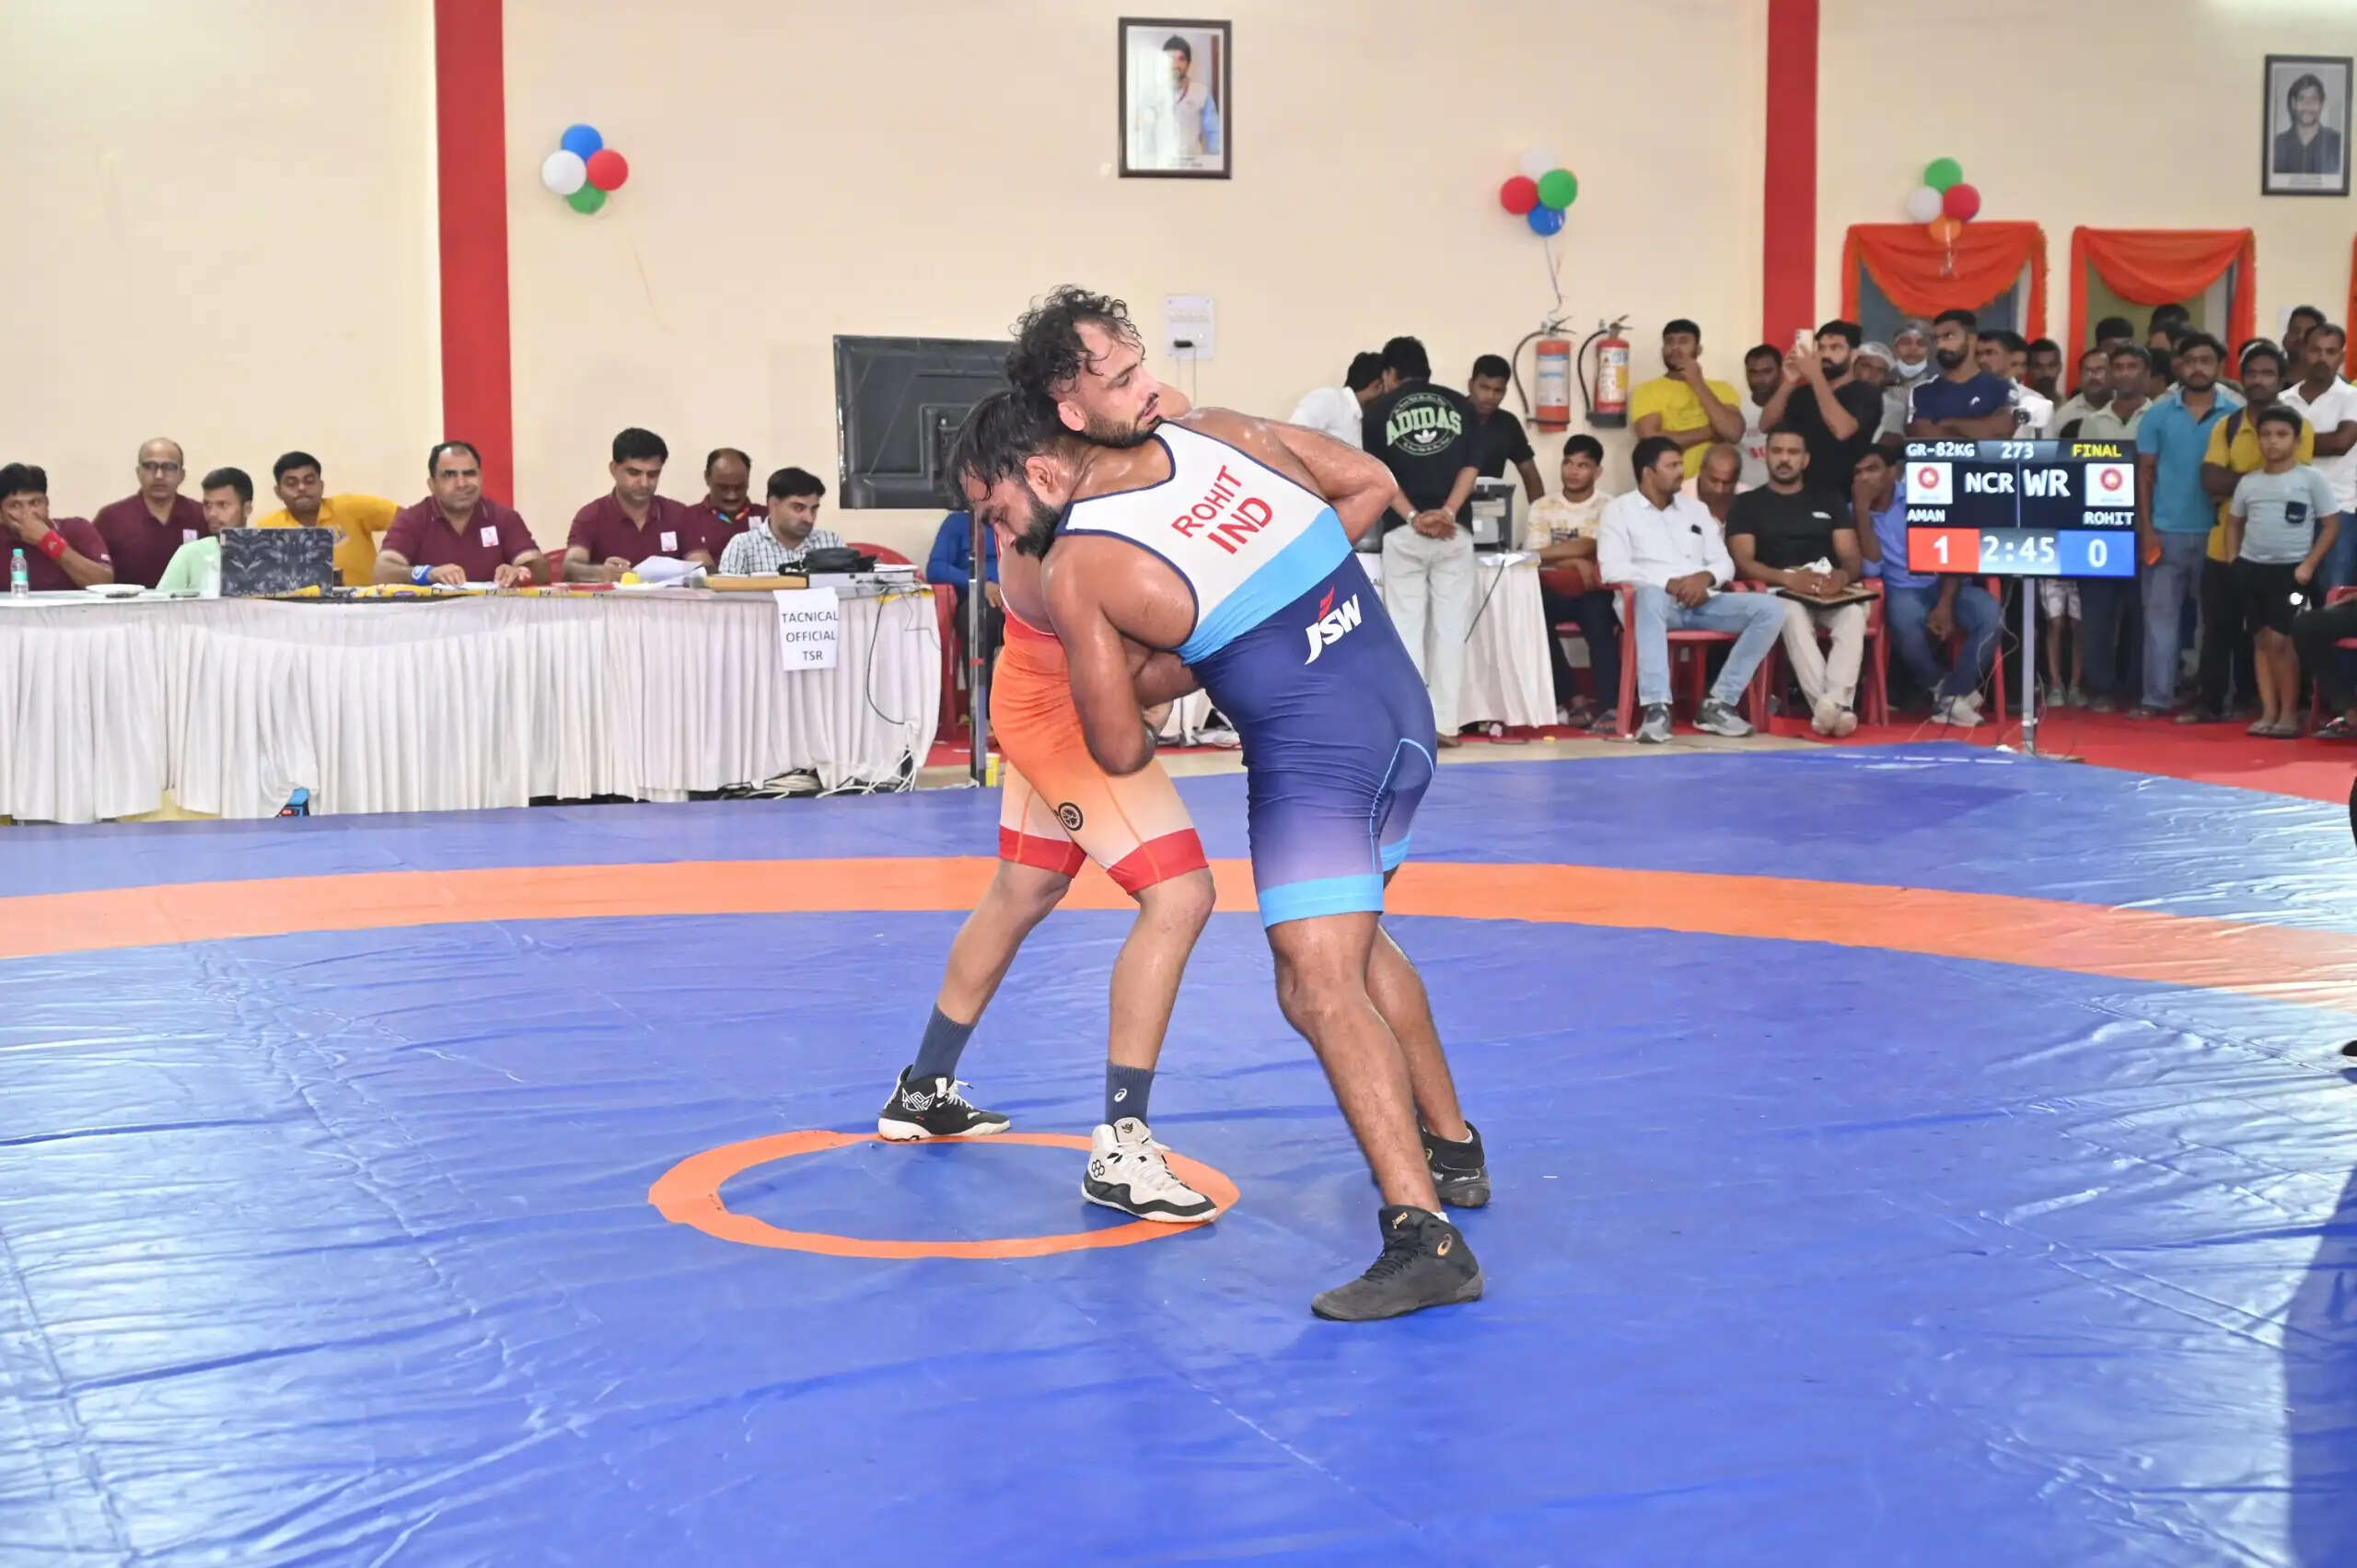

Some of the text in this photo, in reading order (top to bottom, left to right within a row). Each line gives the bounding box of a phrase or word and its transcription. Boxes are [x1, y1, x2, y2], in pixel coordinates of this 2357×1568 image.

[1387, 406, 1462, 447] ADIDAS
[1906, 442, 1975, 457] GR-82KG
[2001, 442, 2035, 459] 273
[2073, 444, 2121, 458] FINAL
[1965, 472, 2015, 494] NCR
[2023, 469, 2071, 497] WR
[1171, 465, 1242, 539] ROHIT
[1206, 497, 1273, 554] IND
[1907, 509, 1945, 522] AMAN
[2084, 511, 2134, 526] ROHIT
[1933, 535, 1949, 564] 1
[1982, 535, 2055, 563] 2:45
[2088, 539, 2108, 568] 0
[782, 611, 839, 623] TACNICAL
[786, 631, 836, 643] OFFICIAL
[1304, 593, 1363, 666] JSW
[803, 650, 823, 661] TSR
